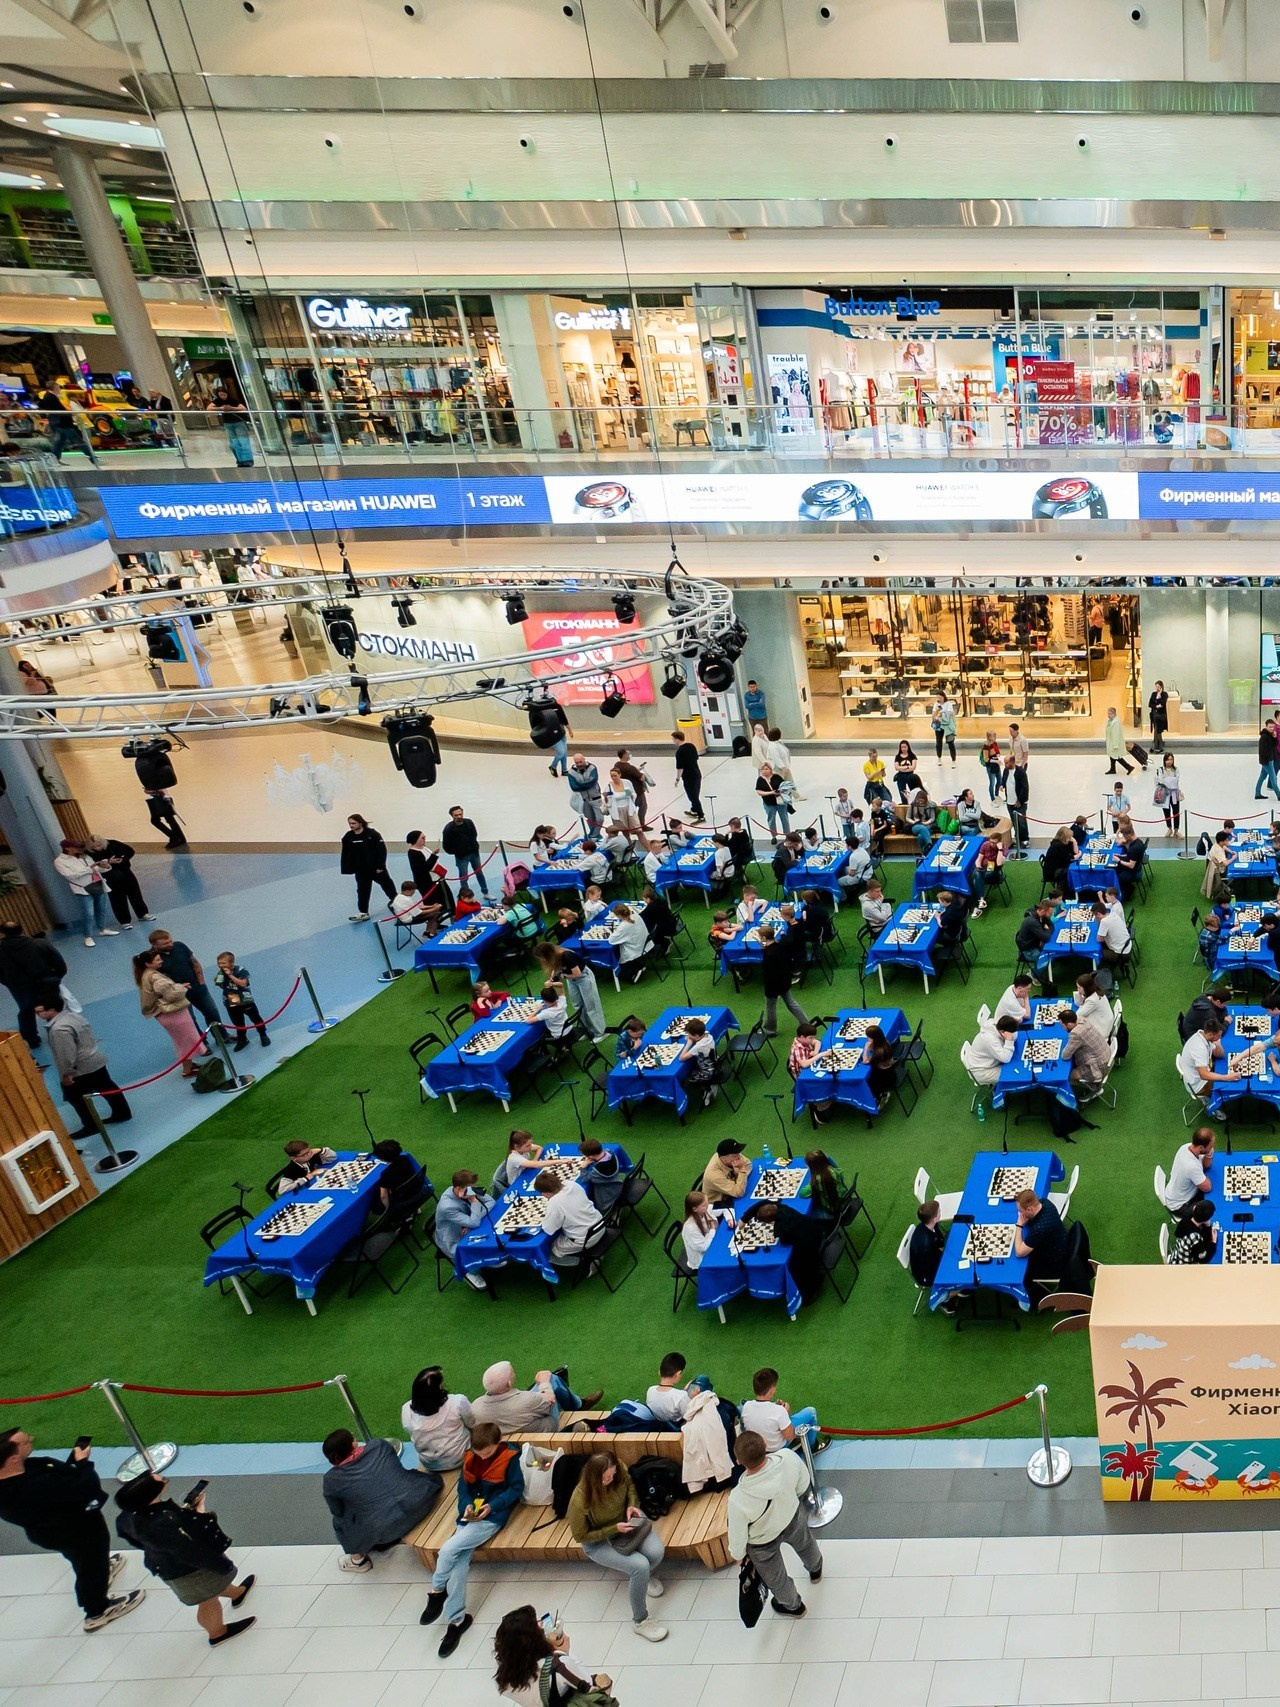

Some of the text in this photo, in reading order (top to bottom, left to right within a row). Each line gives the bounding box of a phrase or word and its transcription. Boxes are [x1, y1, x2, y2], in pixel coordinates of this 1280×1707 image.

[309, 298, 412, 328] Gulliver
[824, 297, 941, 316] Button Blue
[998, 343, 1030, 353] Buttn
[773, 354, 804, 363] trouble
[1040, 416, 1077, 430] 70%
[139, 492, 526, 520] Фирменный магазин HUAWEI 1 этаж
[1159, 488, 1255, 506] Фирменный
[543, 619, 620, 629] СТОКМАНН
[358, 632, 476, 662] СТОКМАНН
